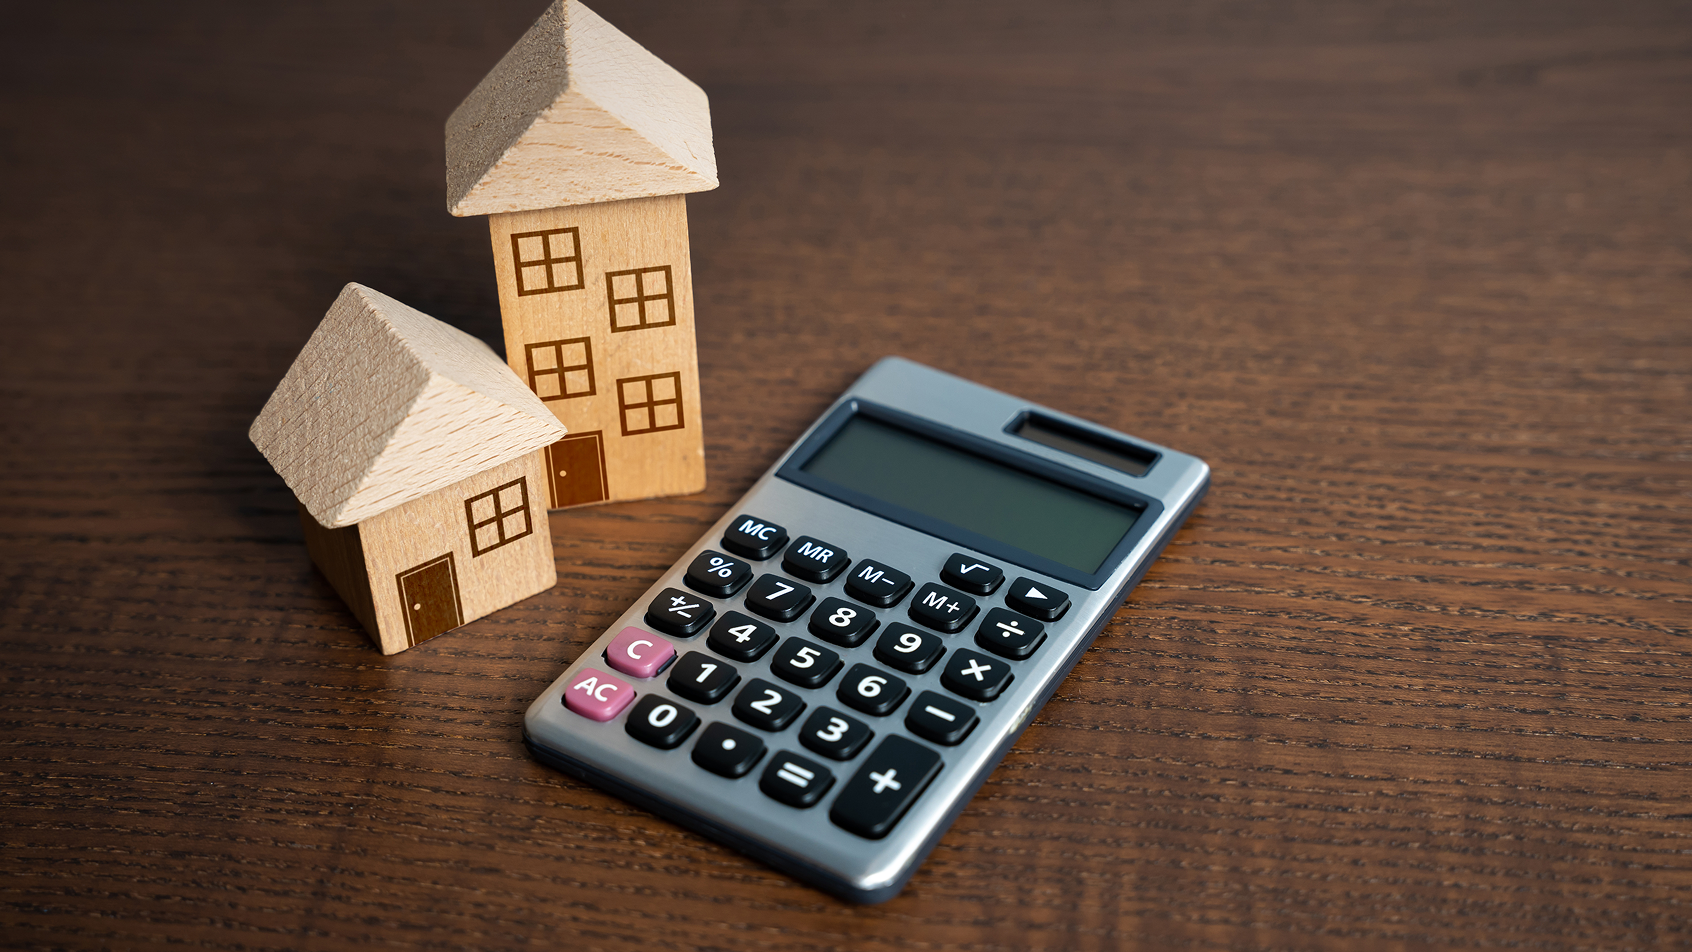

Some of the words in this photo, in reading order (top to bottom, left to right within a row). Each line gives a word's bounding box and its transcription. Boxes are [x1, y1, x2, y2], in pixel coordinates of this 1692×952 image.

[739, 520, 776, 540] MC
[797, 541, 834, 563] MR
[708, 557, 735, 578] %
[766, 582, 794, 600] 7
[922, 591, 960, 613] M+
[829, 607, 857, 627] 8
[728, 624, 757, 643] 4
[893, 633, 922, 653] 9
[627, 640, 653, 659] C
[790, 646, 821, 668] 5
[695, 663, 717, 683] 1
[574, 676, 618, 702] AC
[857, 675, 887, 697] 6
[750, 689, 782, 714] 2
[648, 704, 678, 727] 0
[816, 717, 849, 742] 3
[777, 762, 815, 788] =
[869, 768, 901, 794] +
